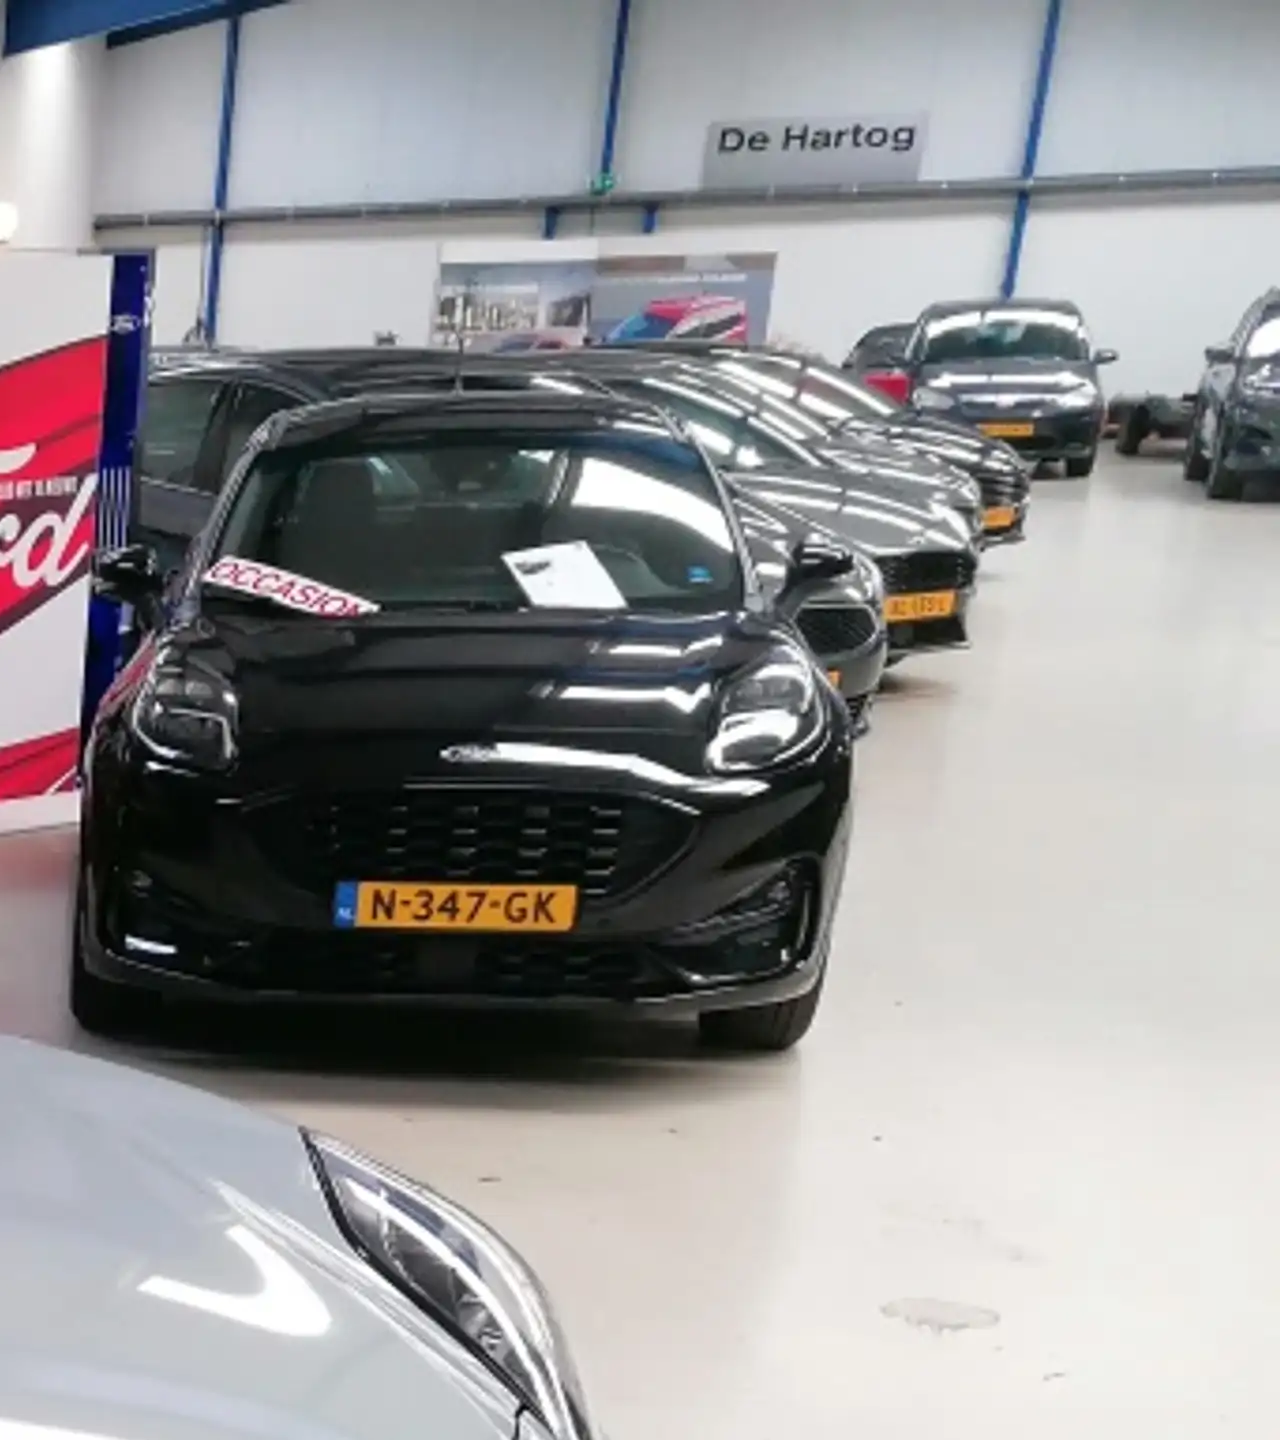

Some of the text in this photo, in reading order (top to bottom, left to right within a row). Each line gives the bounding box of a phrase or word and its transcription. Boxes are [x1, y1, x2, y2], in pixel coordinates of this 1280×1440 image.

[719, 121, 917, 152] De Hartog
[371, 888, 557, 924] N-347-GK
